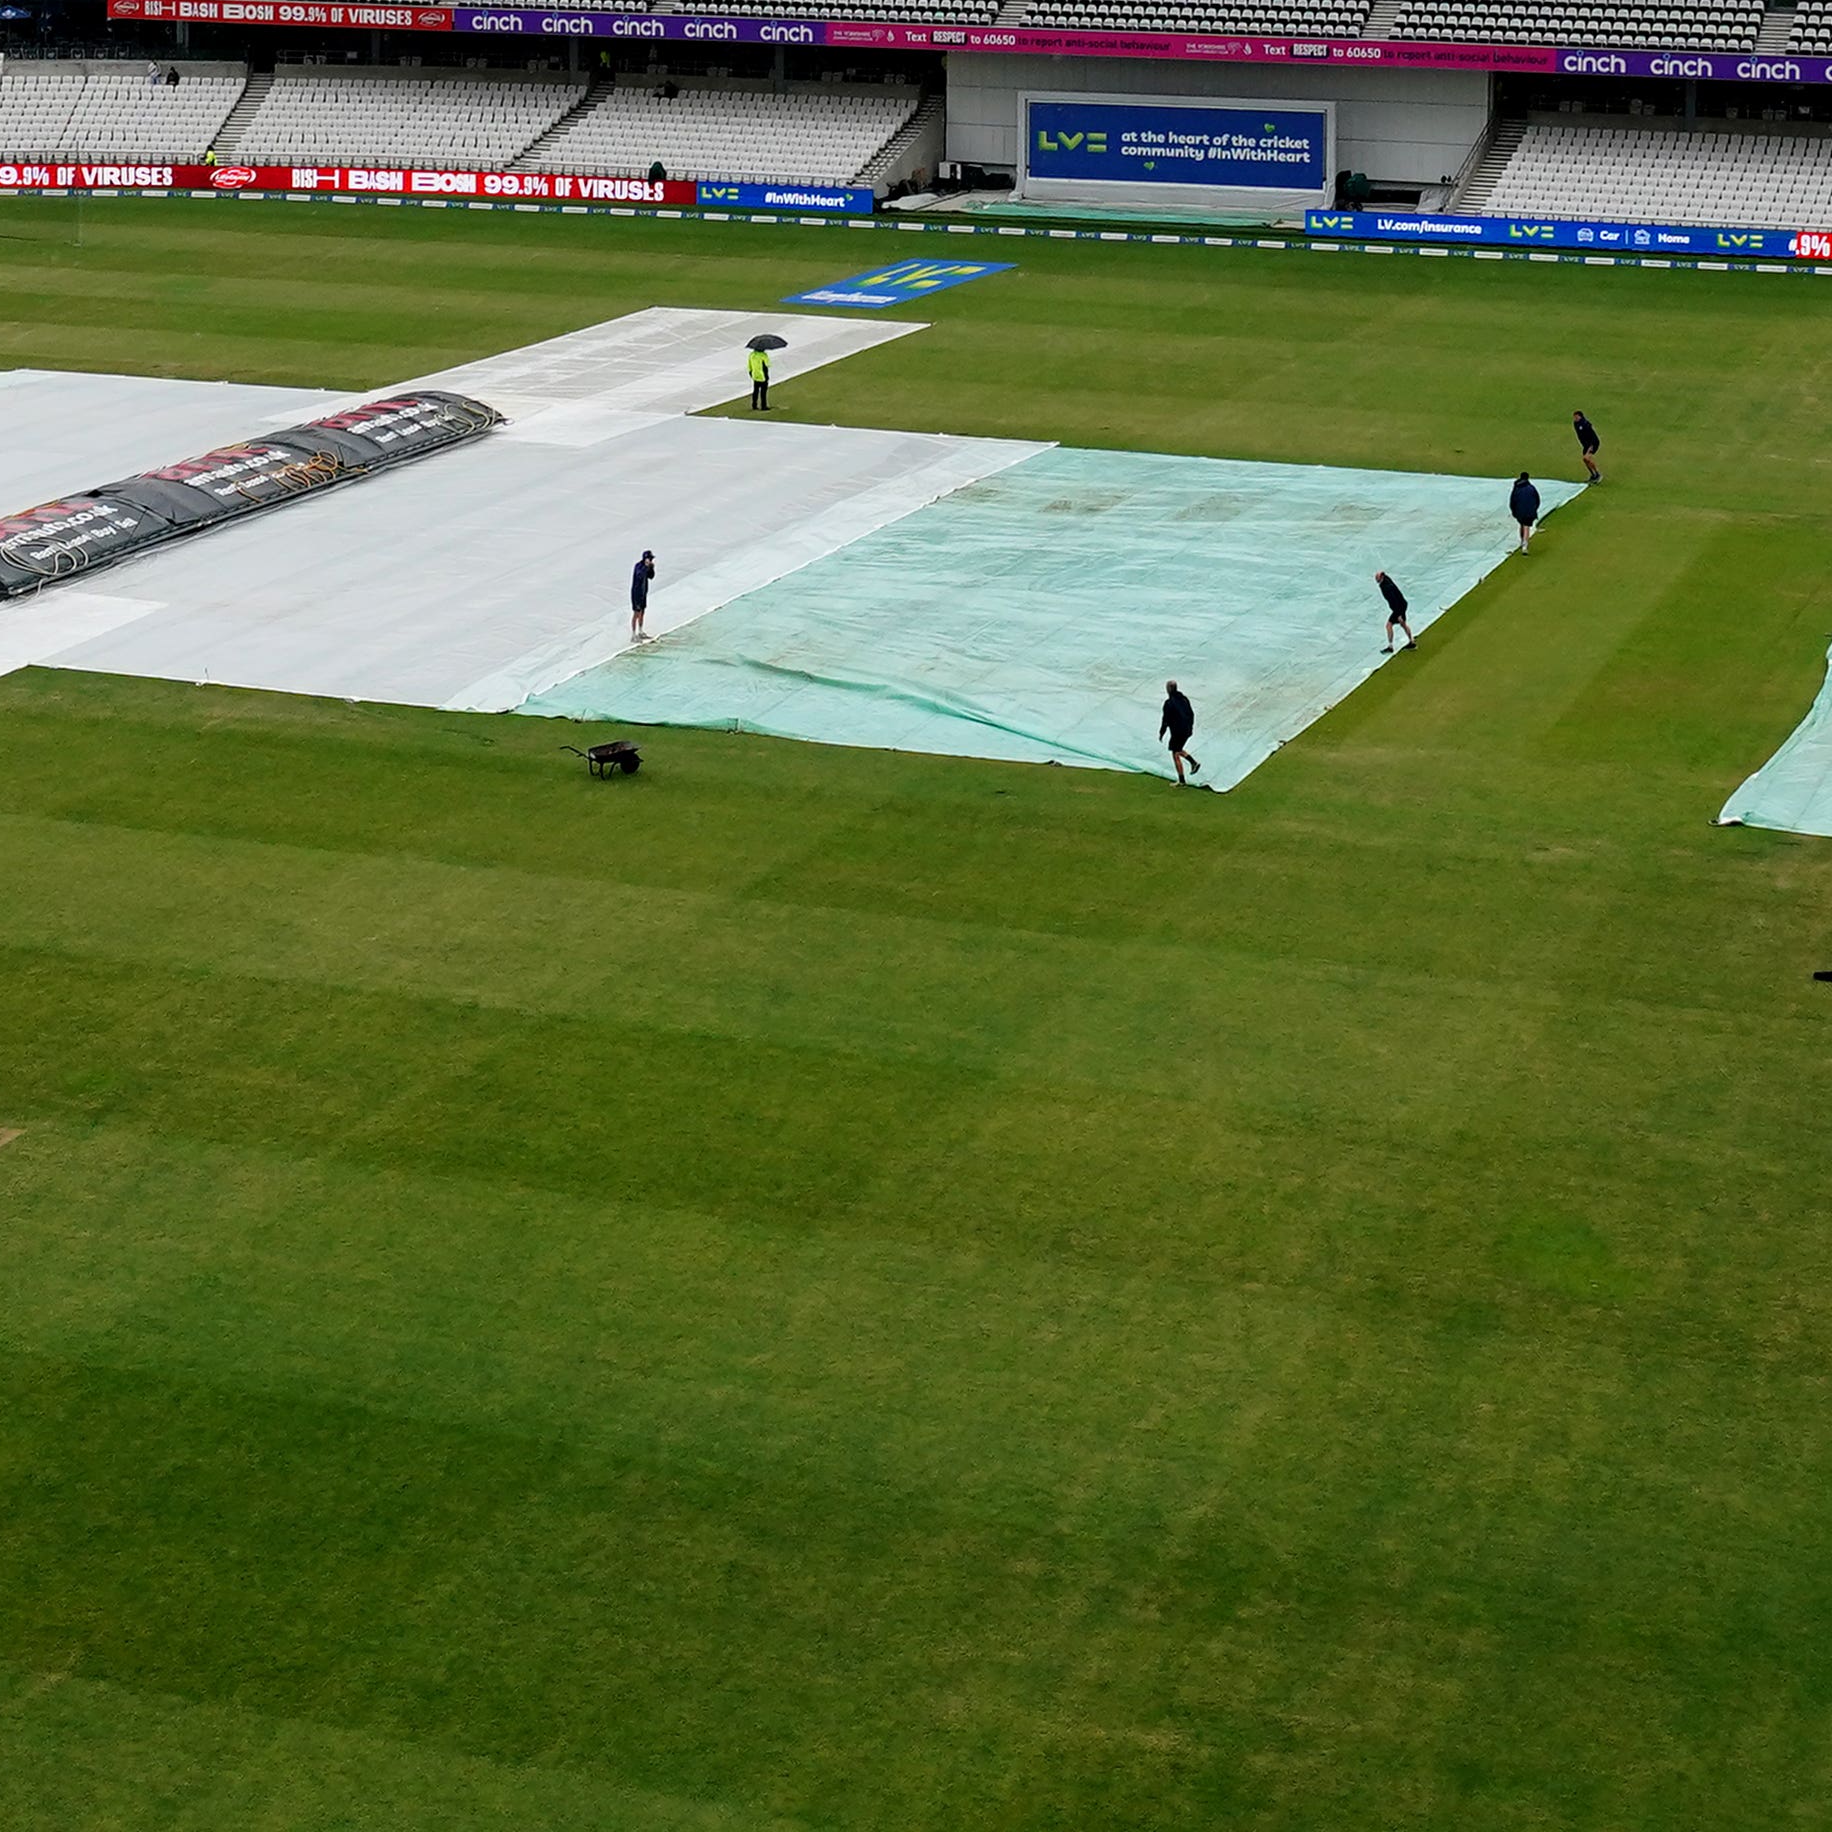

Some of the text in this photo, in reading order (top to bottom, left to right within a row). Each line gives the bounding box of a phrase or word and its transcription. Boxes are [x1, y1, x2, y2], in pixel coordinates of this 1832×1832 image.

[144, 0, 175, 16] BISH
[179, 1, 218, 18] BASH
[223, 3, 274, 20] BOSH
[279, 5, 327, 22] 99.9%
[330, 8, 344, 24] OF
[348, 8, 412, 27] VIRUSES
[472, 11, 522, 32] cinch
[612, 15, 664, 37] cinch
[760, 21, 813, 43] cinch
[905, 31, 927, 42] Text
[933, 31, 966, 44] RESPECT
[970, 34, 981, 44] to
[983, 33, 1016, 45] 60650
[1263, 44, 1286, 55] Text
[1293, 44, 1328, 57] RESPECT
[1332, 47, 1344, 57] to
[1346, 47, 1381, 59] 60650
[1650, 52, 1712, 78] cinch
[1121, 131, 1310, 150] at the heart of the cricket
[1121, 146, 1311, 164] community #InWithHeart
[57, 166, 76, 185] OF
[82, 167, 173, 187] VIRUSES
[292, 169, 665, 202] BISH BASH BOSH 99.9% OF VIRUSES
[765, 192, 846, 208] #InWithHeart
[1377, 218, 1482, 237] LV.com/insurance
[1600, 230, 1690, 245] Car Home
